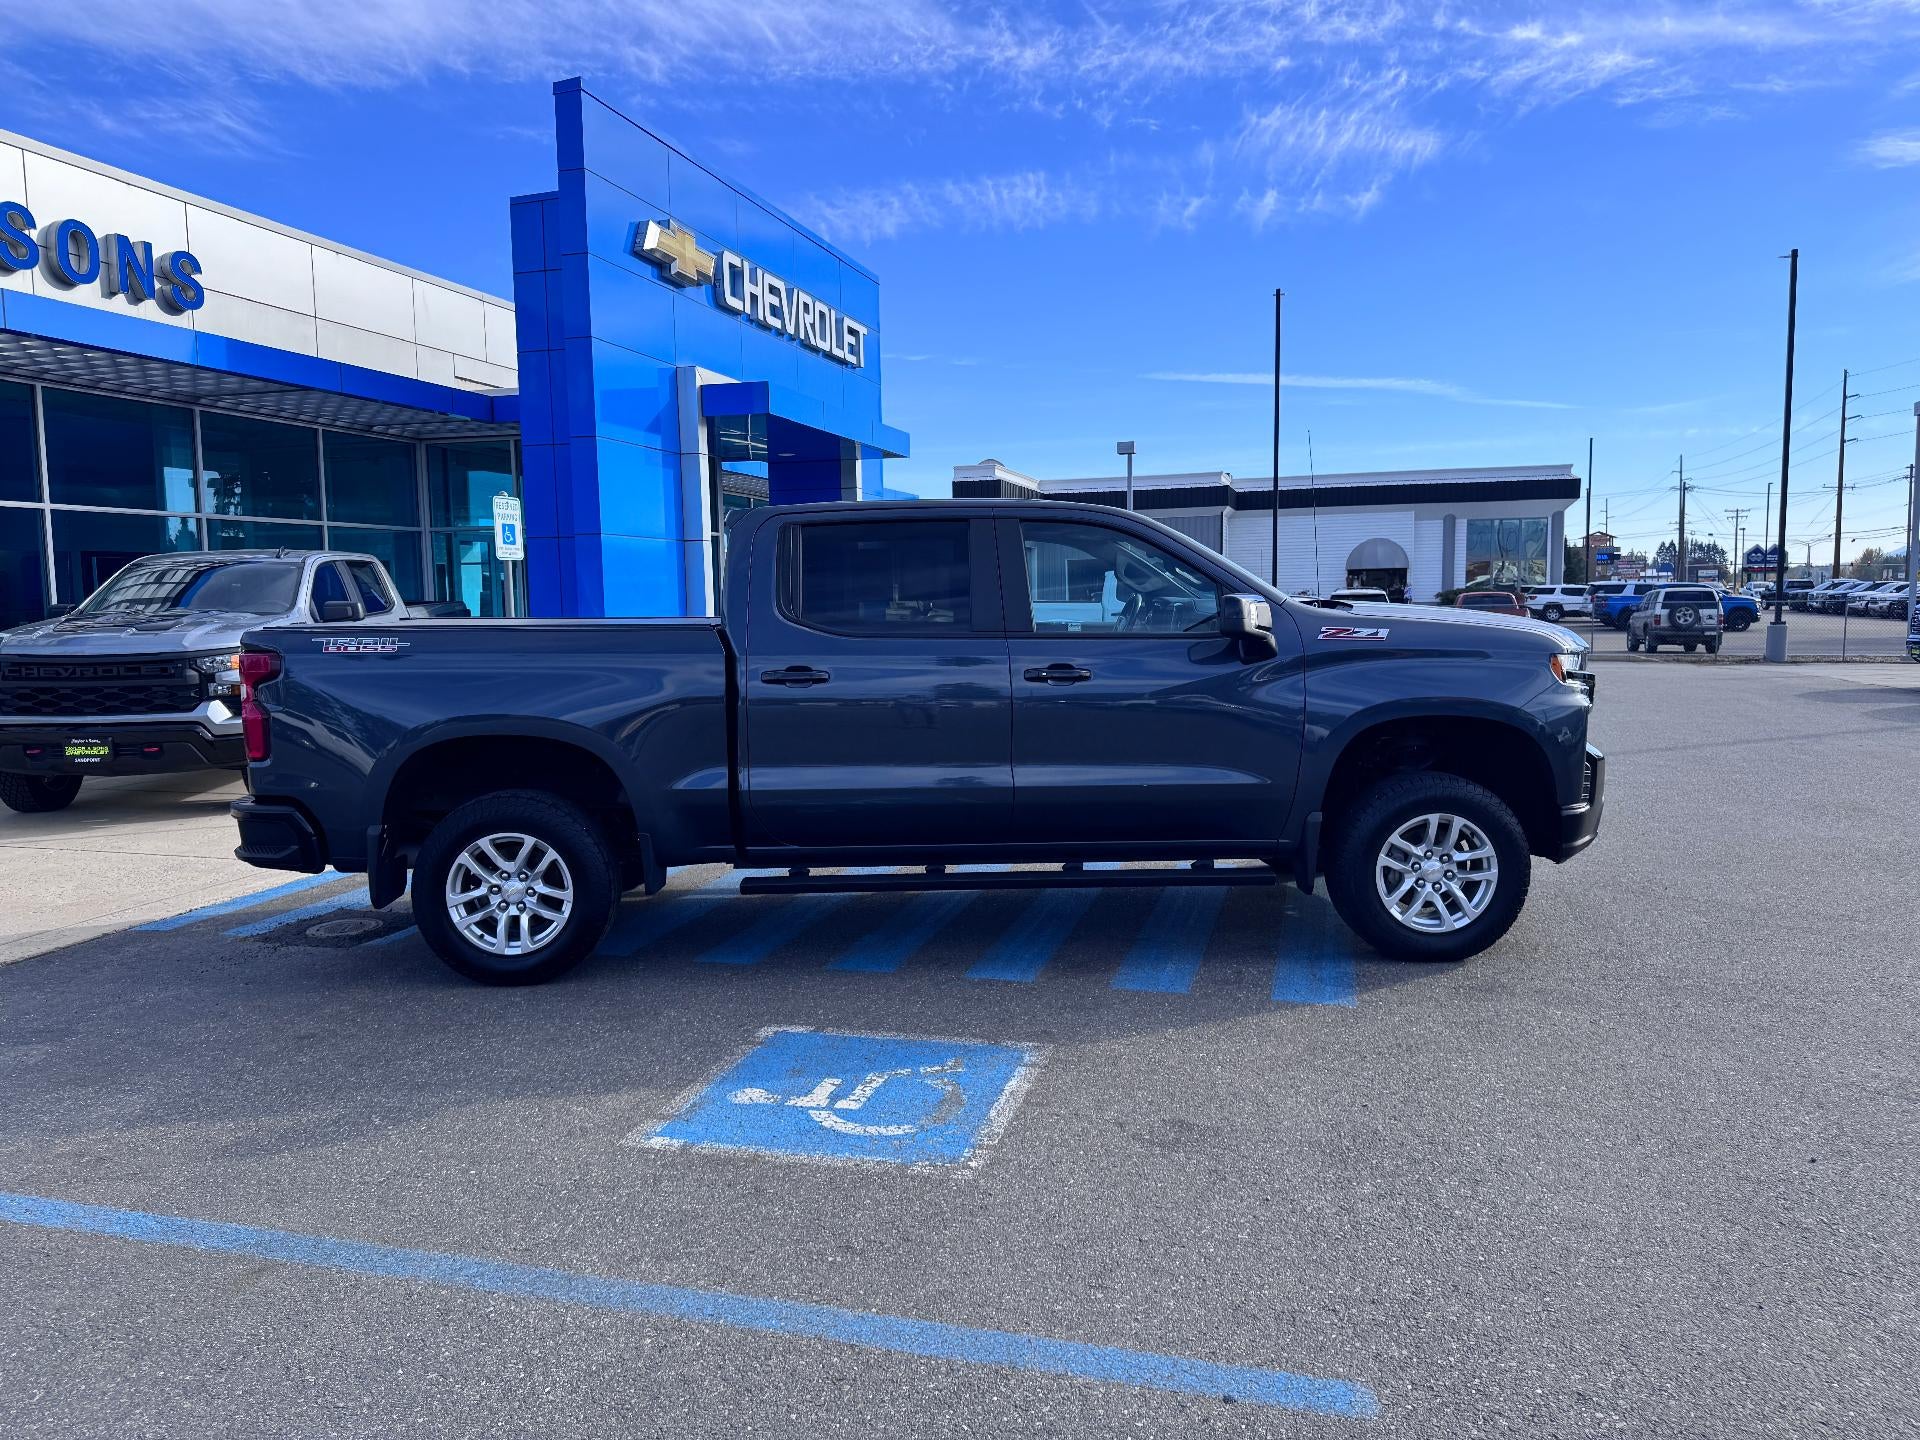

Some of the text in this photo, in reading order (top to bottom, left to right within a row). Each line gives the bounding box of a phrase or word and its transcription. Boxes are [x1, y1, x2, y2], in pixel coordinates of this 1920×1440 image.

[0, 200, 205, 314] SONS
[720, 250, 868, 369] CHEVROLET
[1317, 626, 1390, 641] Z71
[322, 645, 398, 653] BOSS
[5, 664, 177, 678] CHEVROLET
